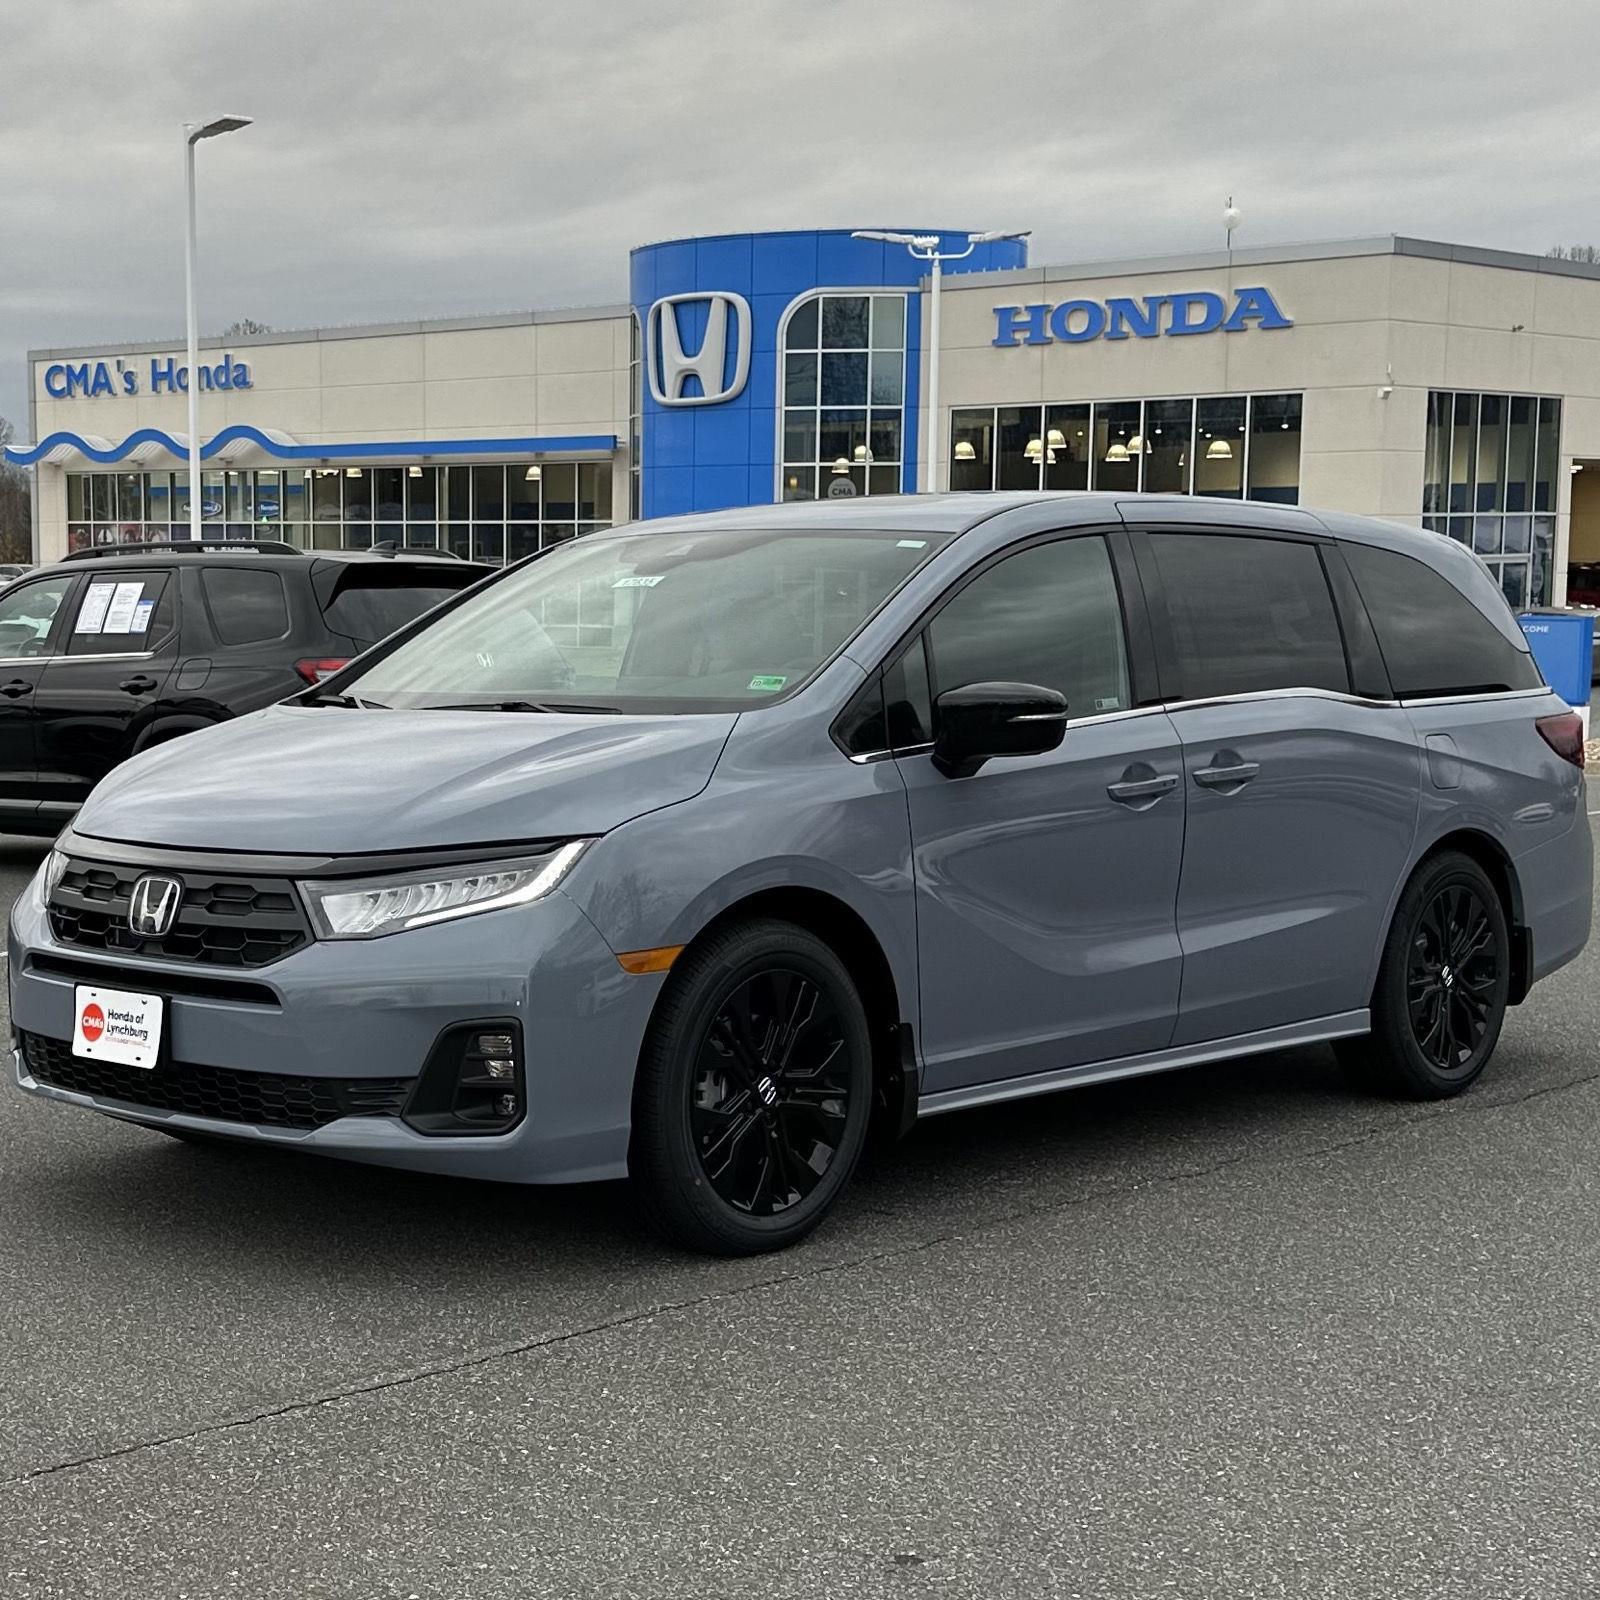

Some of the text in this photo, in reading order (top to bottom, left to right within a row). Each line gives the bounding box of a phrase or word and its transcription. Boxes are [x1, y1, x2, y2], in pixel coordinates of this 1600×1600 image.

[991, 286, 1294, 347] HONDA
[45, 353, 253, 399] CMA's Honda
[831, 487, 853, 496] CMA
[1522, 625, 1550, 633] COME
[107, 1009, 145, 1025] Honda of
[106, 1022, 149, 1041] Lynchburg
